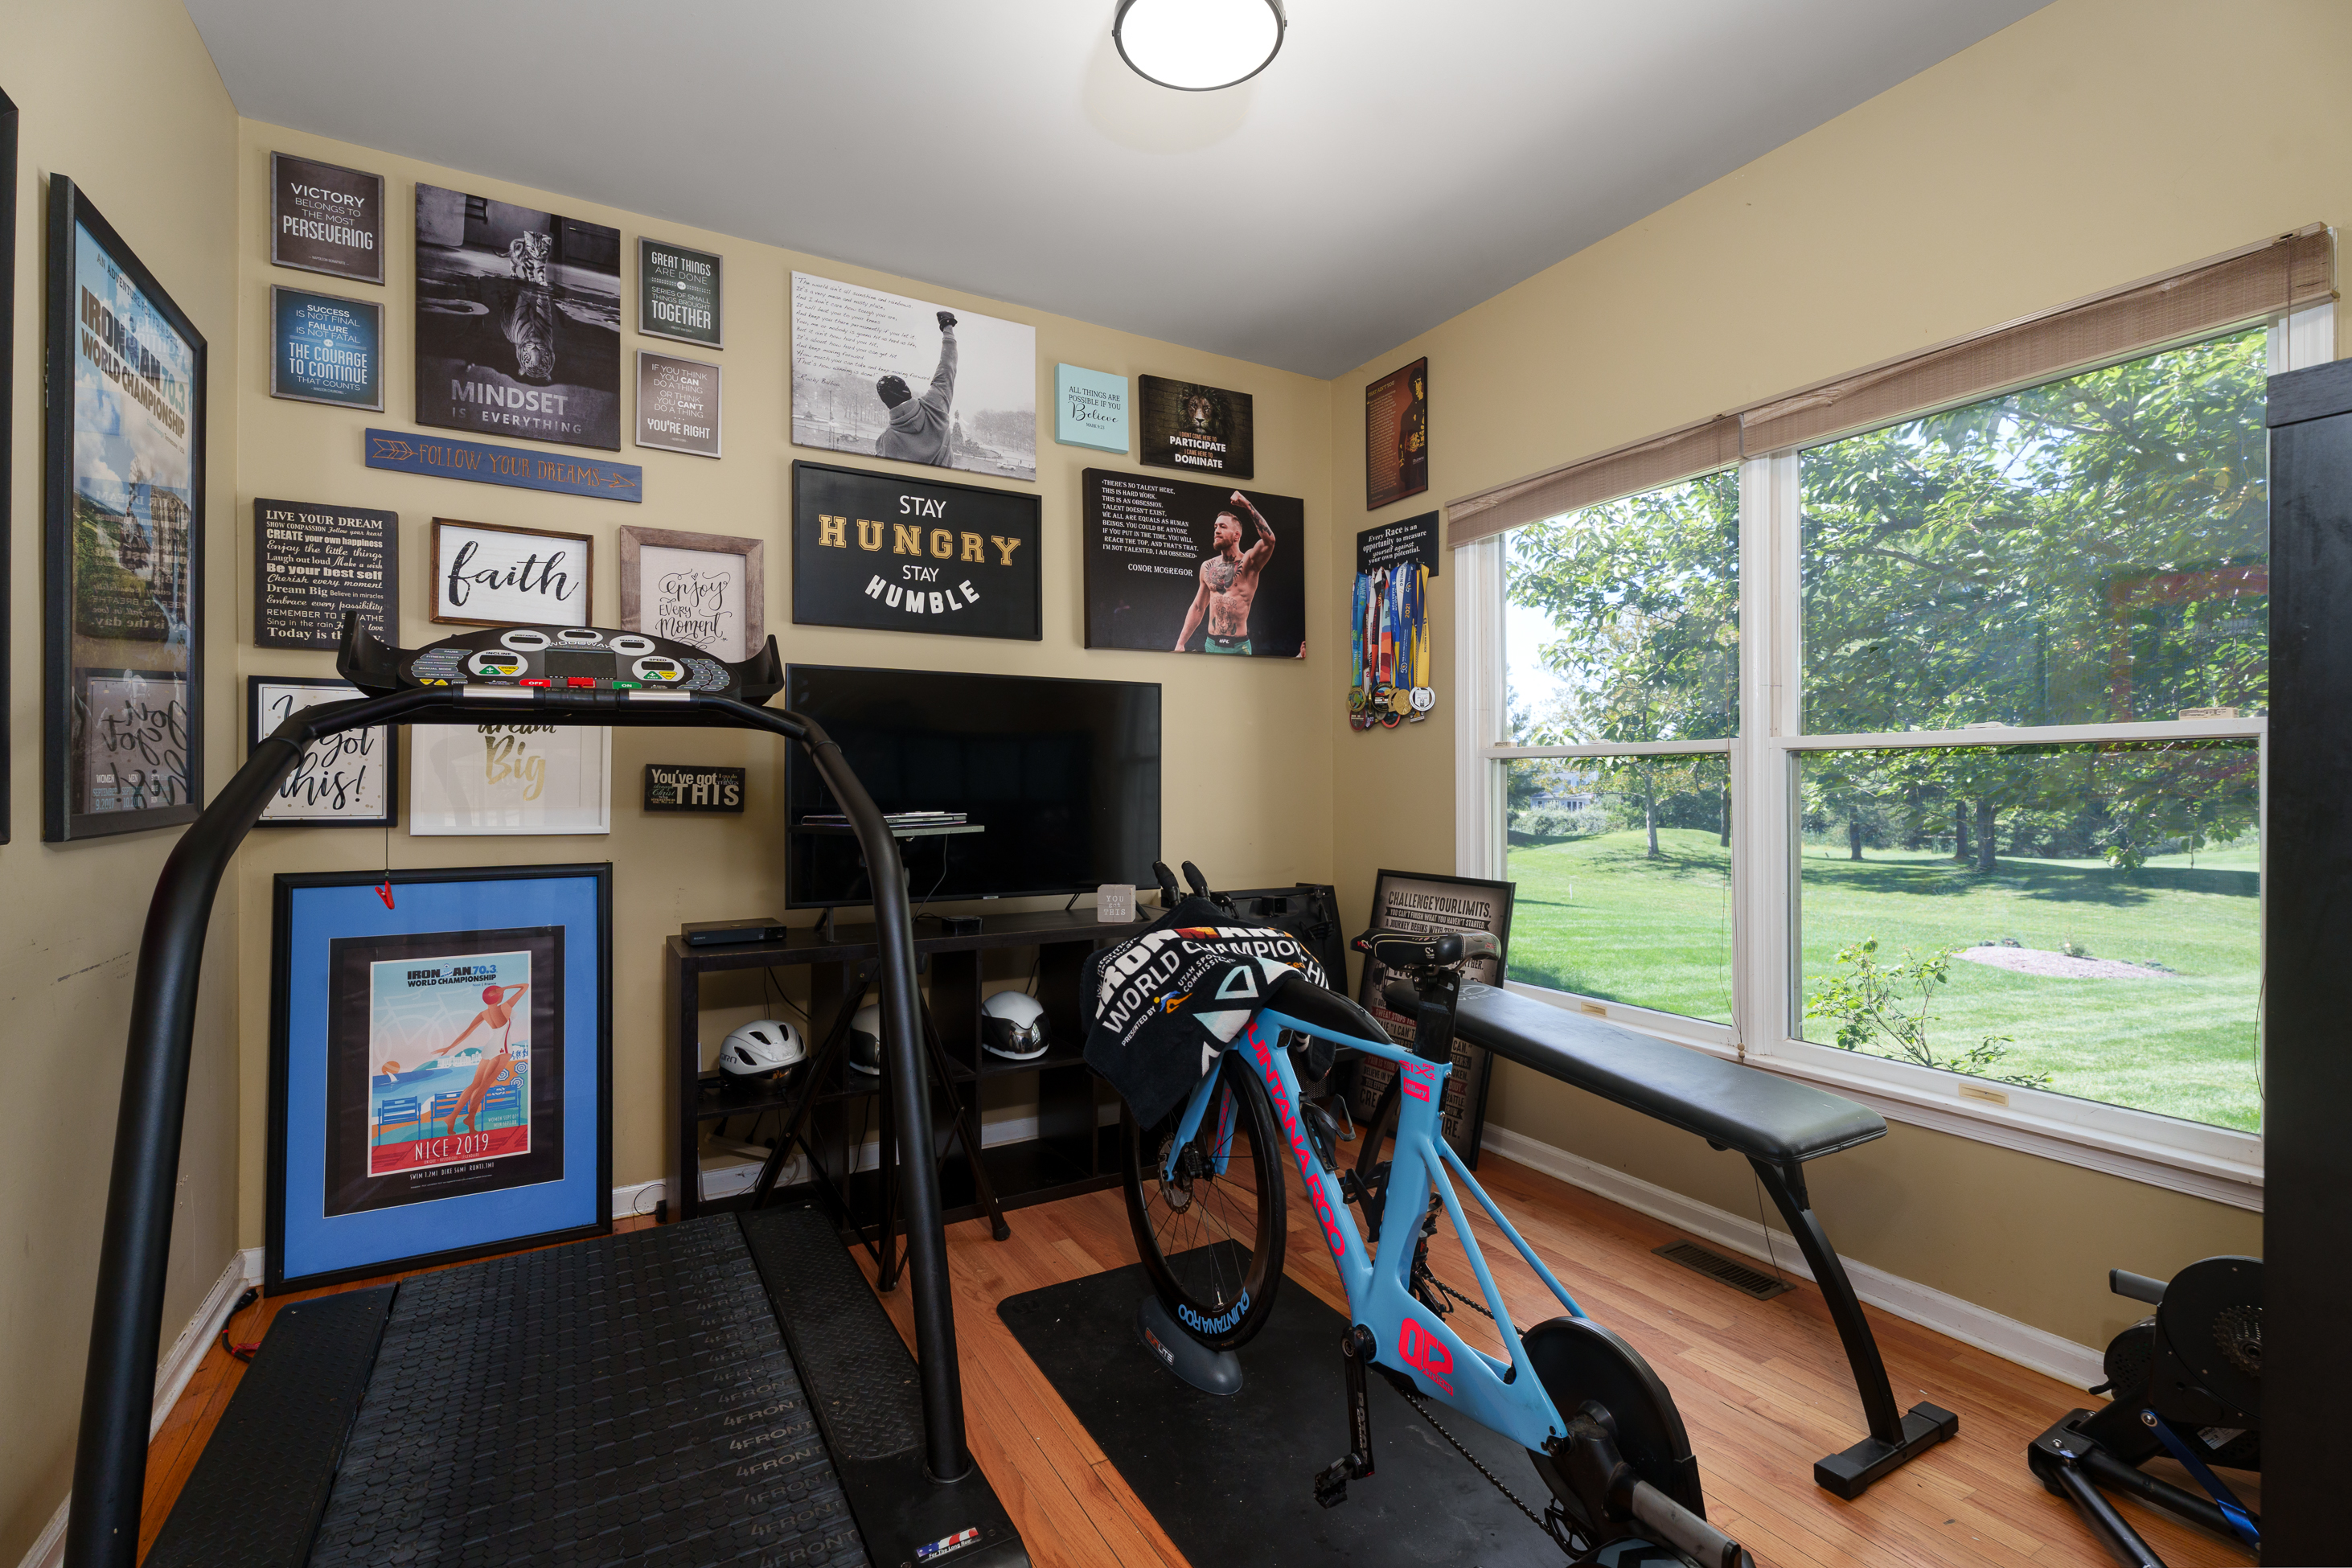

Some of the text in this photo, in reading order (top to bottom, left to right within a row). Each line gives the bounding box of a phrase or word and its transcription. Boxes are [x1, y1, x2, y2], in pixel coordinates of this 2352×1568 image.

[290, 183, 365, 208] VICTORY
[295, 197, 361, 217] BELONGS TO
[302, 208, 355, 226] THE MOST
[283, 215, 373, 250] PERSEVERING
[651, 252, 711, 277] GREAT THINGS
[655, 266, 708, 285] ARE DONE
[651, 293, 711, 310] THINGS BROUGHT
[852, 291, 876, 300] sunshine
[296, 310, 361, 327] IS NOT FINAL
[307, 305, 350, 318] SUCCESS
[651, 299, 711, 330] TOGETHER
[308, 321, 349, 335] FAILURE
[289, 342, 367, 368] THE COURAGE
[289, 358, 367, 384] TO CONTINUE
[659, 372, 699, 386] YOU CAN
[660, 365, 679, 376] YOU
[681, 369, 708, 380] THINK
[81, 327, 185, 439] WORLD CHAMPIONSHIP
[162, 367, 186, 415] 70.3
[296, 376, 361, 391] THAT COUNTS
[654, 379, 667, 387] DO
[676, 383, 704, 394] THING
[1069, 386, 1082, 394] ALL
[1082, 388, 1106, 399] THINGS
[451, 379, 569, 416] MINDSET
[1069, 394, 1098, 406] POSSIBLE
[1108, 402, 1121, 410] YOU
[452, 407, 582, 435] IS EVERYTHING
[1068, 401, 1119, 423] Believe
[647, 417, 710, 440] YOU'RE RIGHT
[1170, 436, 1226, 453] PARTICIPATE
[419, 444, 601, 486] FOLLOW YOUR DREAMS
[1175, 454, 1222, 468] DOMINATE
[899, 495, 947, 519] STAY
[266, 510, 383, 530] LIVE YOUR DREAM
[266, 528, 383, 548] CREATE your own happiness
[819, 514, 1021, 566] HUNGRY
[1363, 537, 1394, 553] opportunity
[1403, 531, 1426, 541] measure
[1369, 533, 1384, 542] Every
[1385, 527, 1403, 537] Race
[266, 540, 383, 561] Enjoy the little things
[1369, 556, 1381, 565] your
[1394, 546, 1420, 559] potential.
[1373, 541, 1414, 559] yourself against
[266, 563, 383, 580] Be your best self
[448, 540, 579, 606] faith
[902, 565, 940, 582] STAY
[1127, 564, 1193, 577] CONOR MCGREGOR
[266, 584, 328, 597] Dream Big
[662, 573, 728, 611] enjoy
[864, 574, 980, 614] HUMBLE
[548, 641, 614, 649] WOODWAY
[319, 726, 376, 768] got
[485, 735, 545, 801] Big
[651, 769, 693, 784] You've
[697, 773, 717, 787] got
[671, 783, 739, 806] THIS
[1389, 891, 1492, 918] CHALLENGE YOUR LIMITS.
[1410, 911, 1424, 920] FINISH
[1424, 913, 1437, 922] WHAT
[1438, 915, 1446, 923] YOU
[473, 964, 497, 975] 70.3
[1177, 966, 1196, 987] UTAH
[408, 974, 497, 987] WORLD CHAMPIONSHIP
[1102, 950, 1180, 1034] WORLD
[1122, 1005, 1156, 1047] PRESENTED BY
[1405, 1082, 1427, 1098] Hillary
[1245, 1016, 1345, 1257] UINTANA ROO
[415, 1133, 489, 1161] NICE 2019
[441, 1168, 453, 1176] BIKE
[1146, 1330, 1173, 1363] SUNLITE
[729, 1420, 813, 1450] 4FRONT
[736, 1445, 823, 1477] 4FRONT
[948, 1543, 960, 1551] Long
